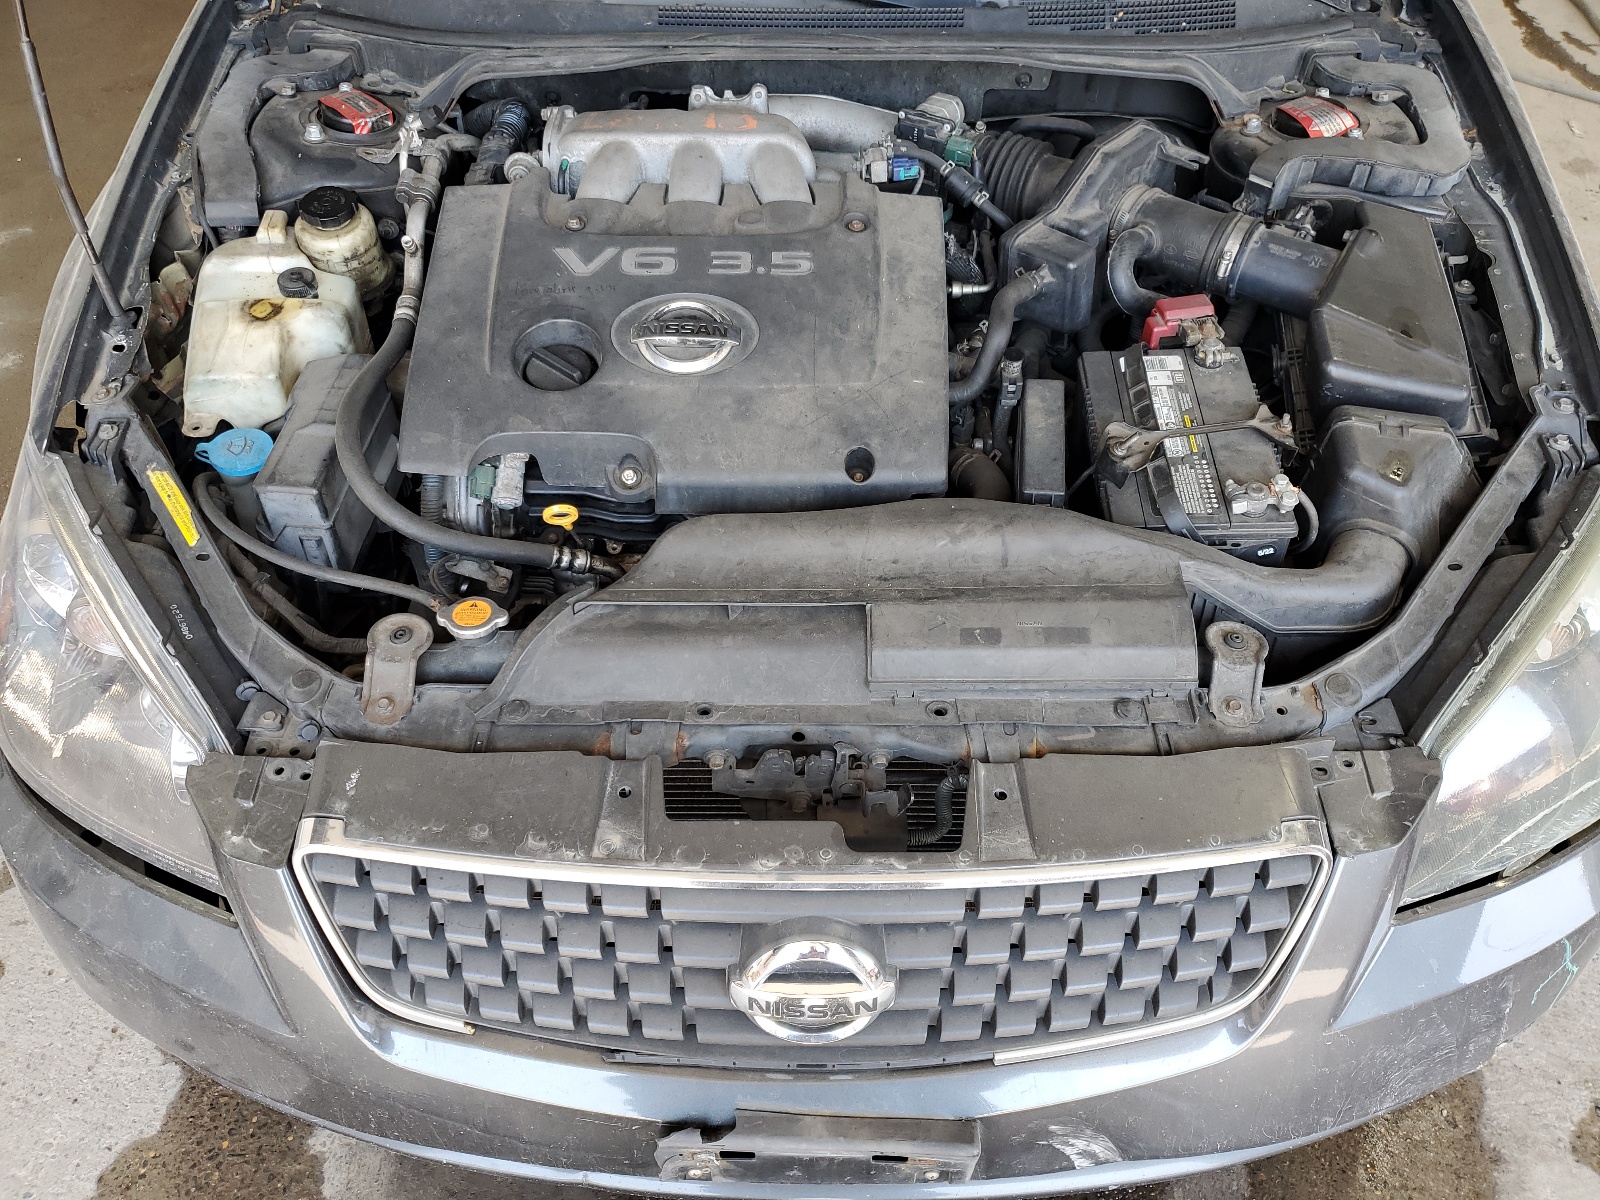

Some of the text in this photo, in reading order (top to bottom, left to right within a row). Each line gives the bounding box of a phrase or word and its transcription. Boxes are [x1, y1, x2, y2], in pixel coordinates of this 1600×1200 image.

[553, 247, 814, 276] V6 3.5
[642, 322, 728, 338] NISSAN
[747, 996, 878, 1019] NISSAN
